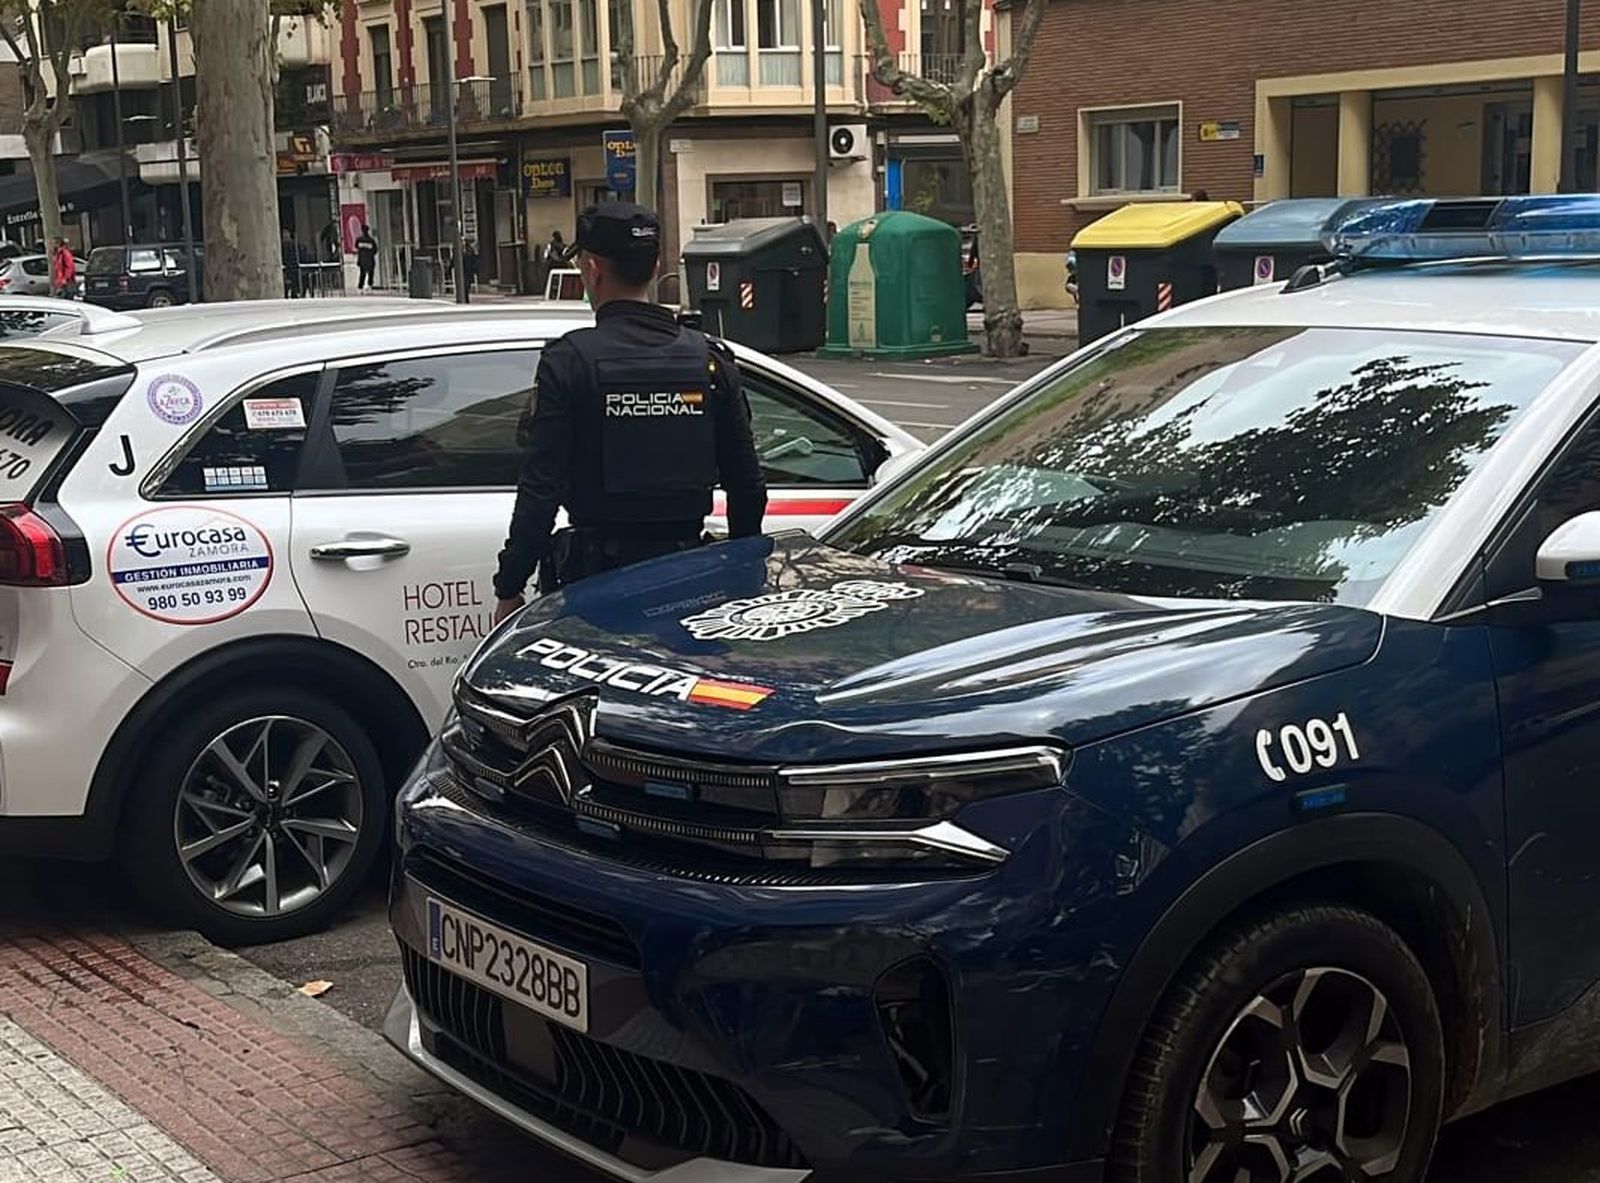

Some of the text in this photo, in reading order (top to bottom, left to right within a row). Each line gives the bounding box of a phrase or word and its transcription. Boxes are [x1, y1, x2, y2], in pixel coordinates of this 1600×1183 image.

[605, 393, 684, 405] POLICIA
[605, 405, 704, 418] NACIONAL
[108, 435, 136, 477] J
[188, 545, 250, 558] ZAMORA
[179, 559, 260, 577] INMOBILIARIA
[136, 574, 252, 594] www.eurocasazamora.com
[403, 580, 483, 611] HOTEL
[147, 586, 247, 611] 980 50 93 99
[404, 613, 493, 646] RESTAU
[1280, 712, 1360, 774] 091
[441, 913, 580, 1018] CNP2328BB
